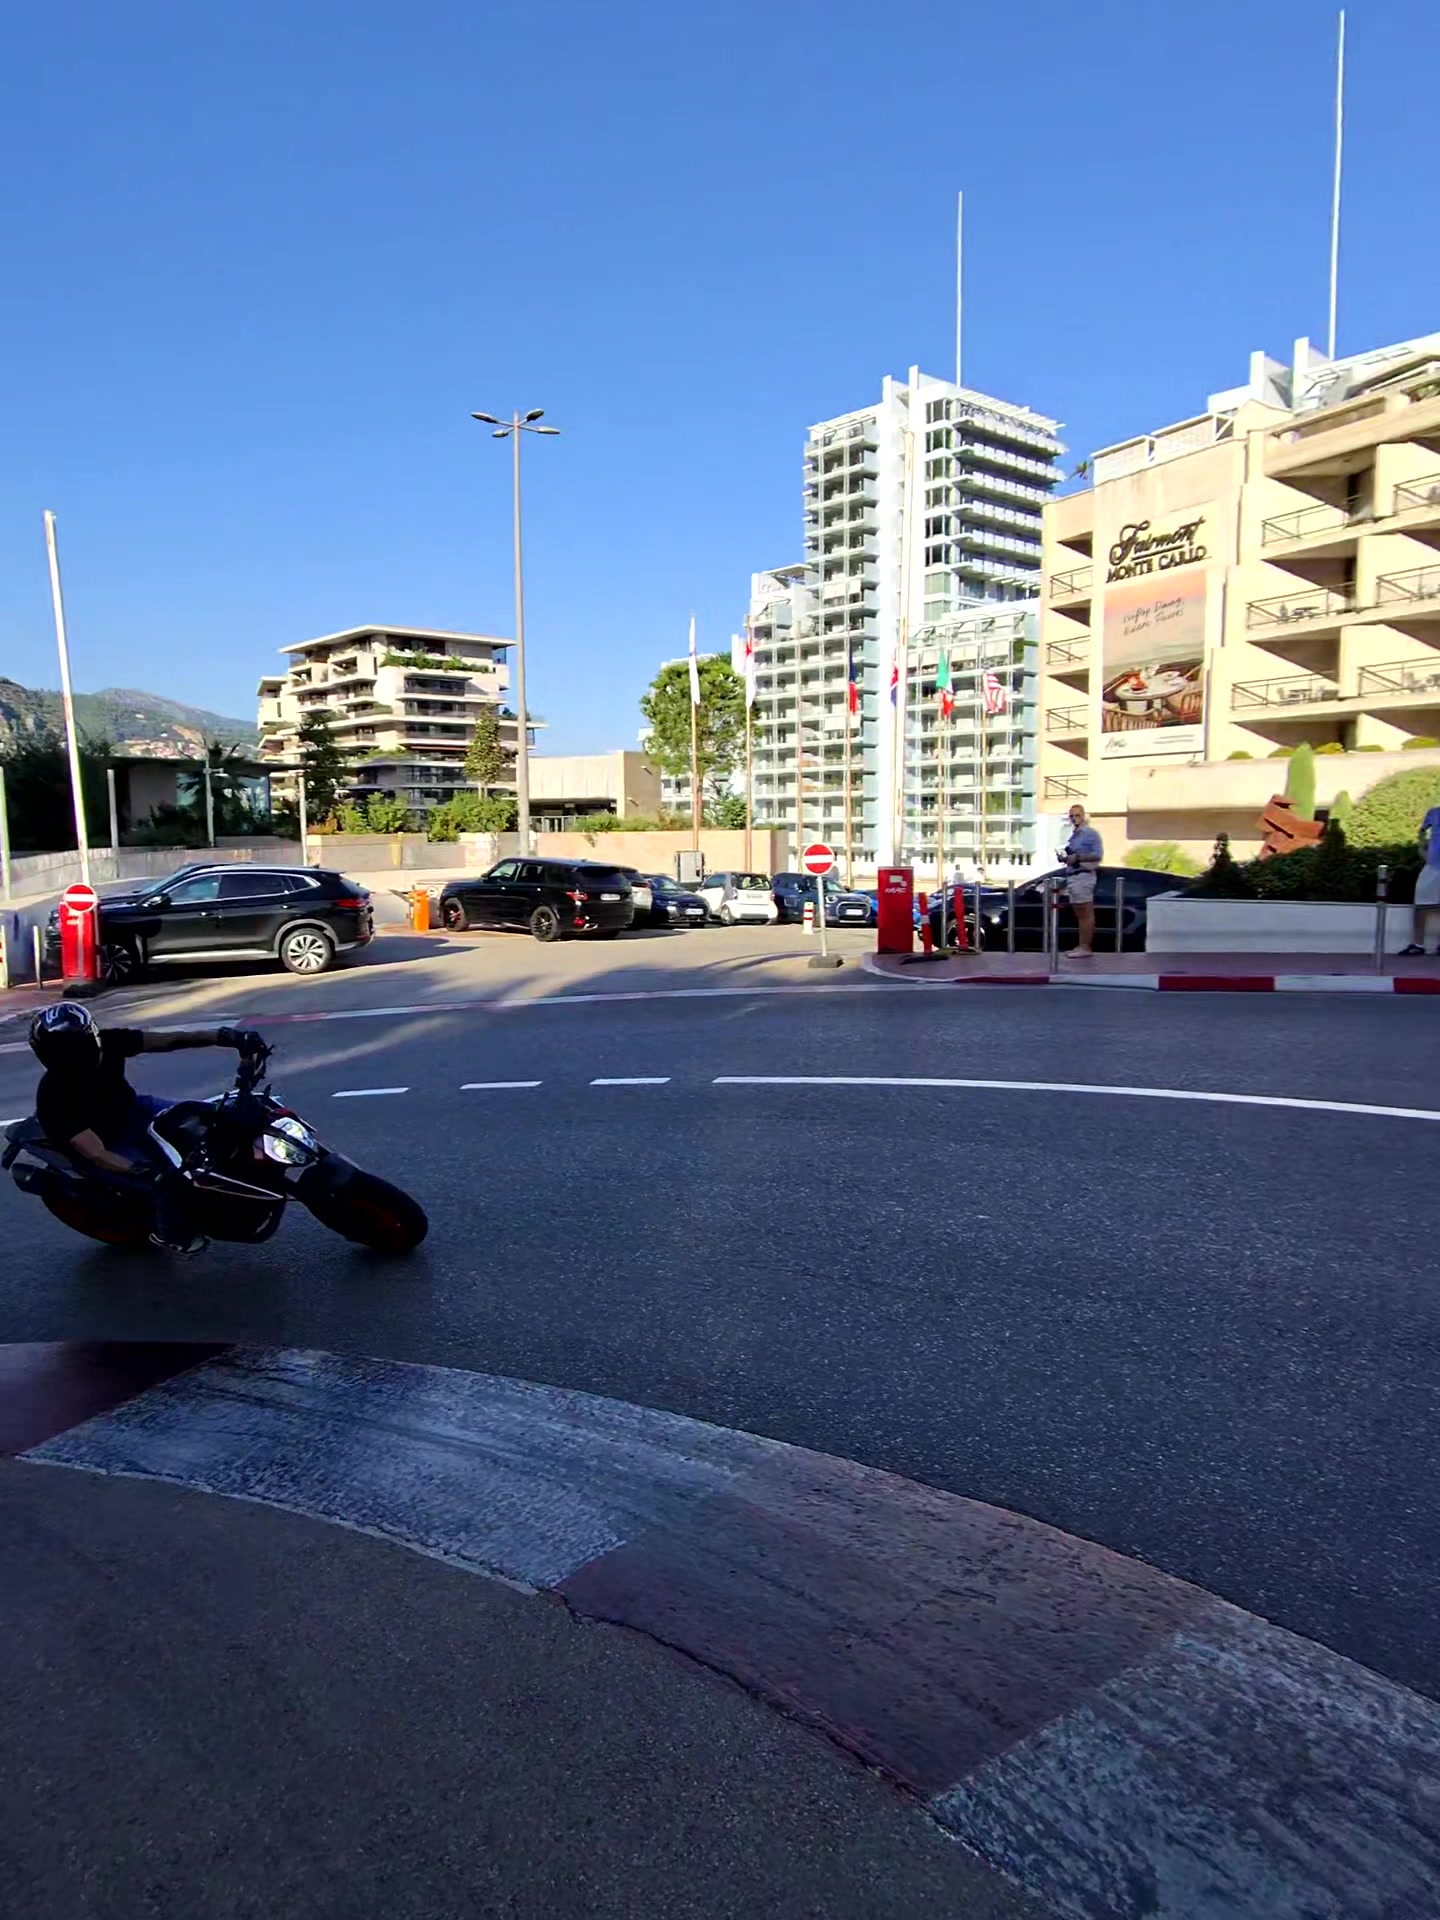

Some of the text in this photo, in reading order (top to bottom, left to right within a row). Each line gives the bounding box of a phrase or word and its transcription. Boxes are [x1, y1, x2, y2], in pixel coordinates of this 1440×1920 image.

[1109, 515, 1207, 566] Fairmont
[1105, 545, 1208, 584] MONTE CARLO
